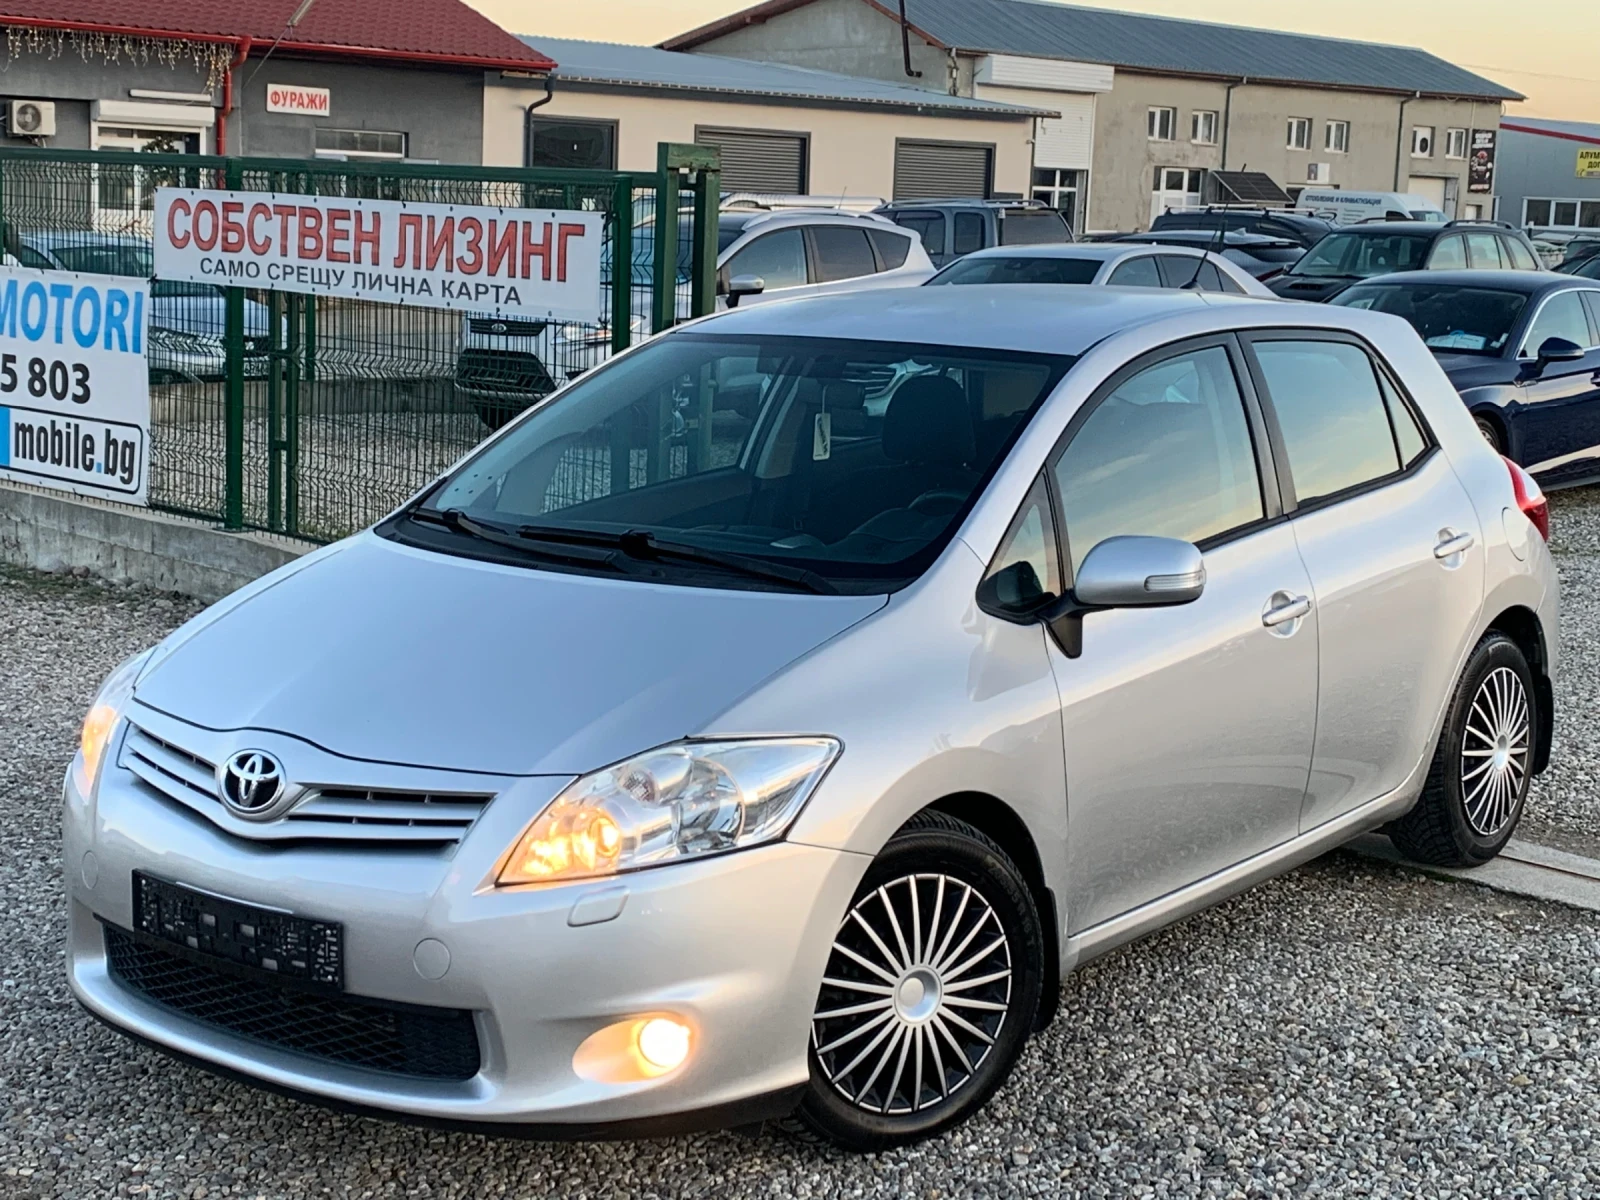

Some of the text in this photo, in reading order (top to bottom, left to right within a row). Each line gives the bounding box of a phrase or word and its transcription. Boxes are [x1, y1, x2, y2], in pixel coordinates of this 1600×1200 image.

[270, 90, 327, 110] ФУРАЖИ
[167, 197, 586, 283] СОБСТВЕН ЛИЗИНГ
[200, 257, 522, 306] САМО СРЕЩУ ЛИЧНА КАРТА
[27, 356, 91, 404] 803
[14, 420, 136, 485] mobile.bg
